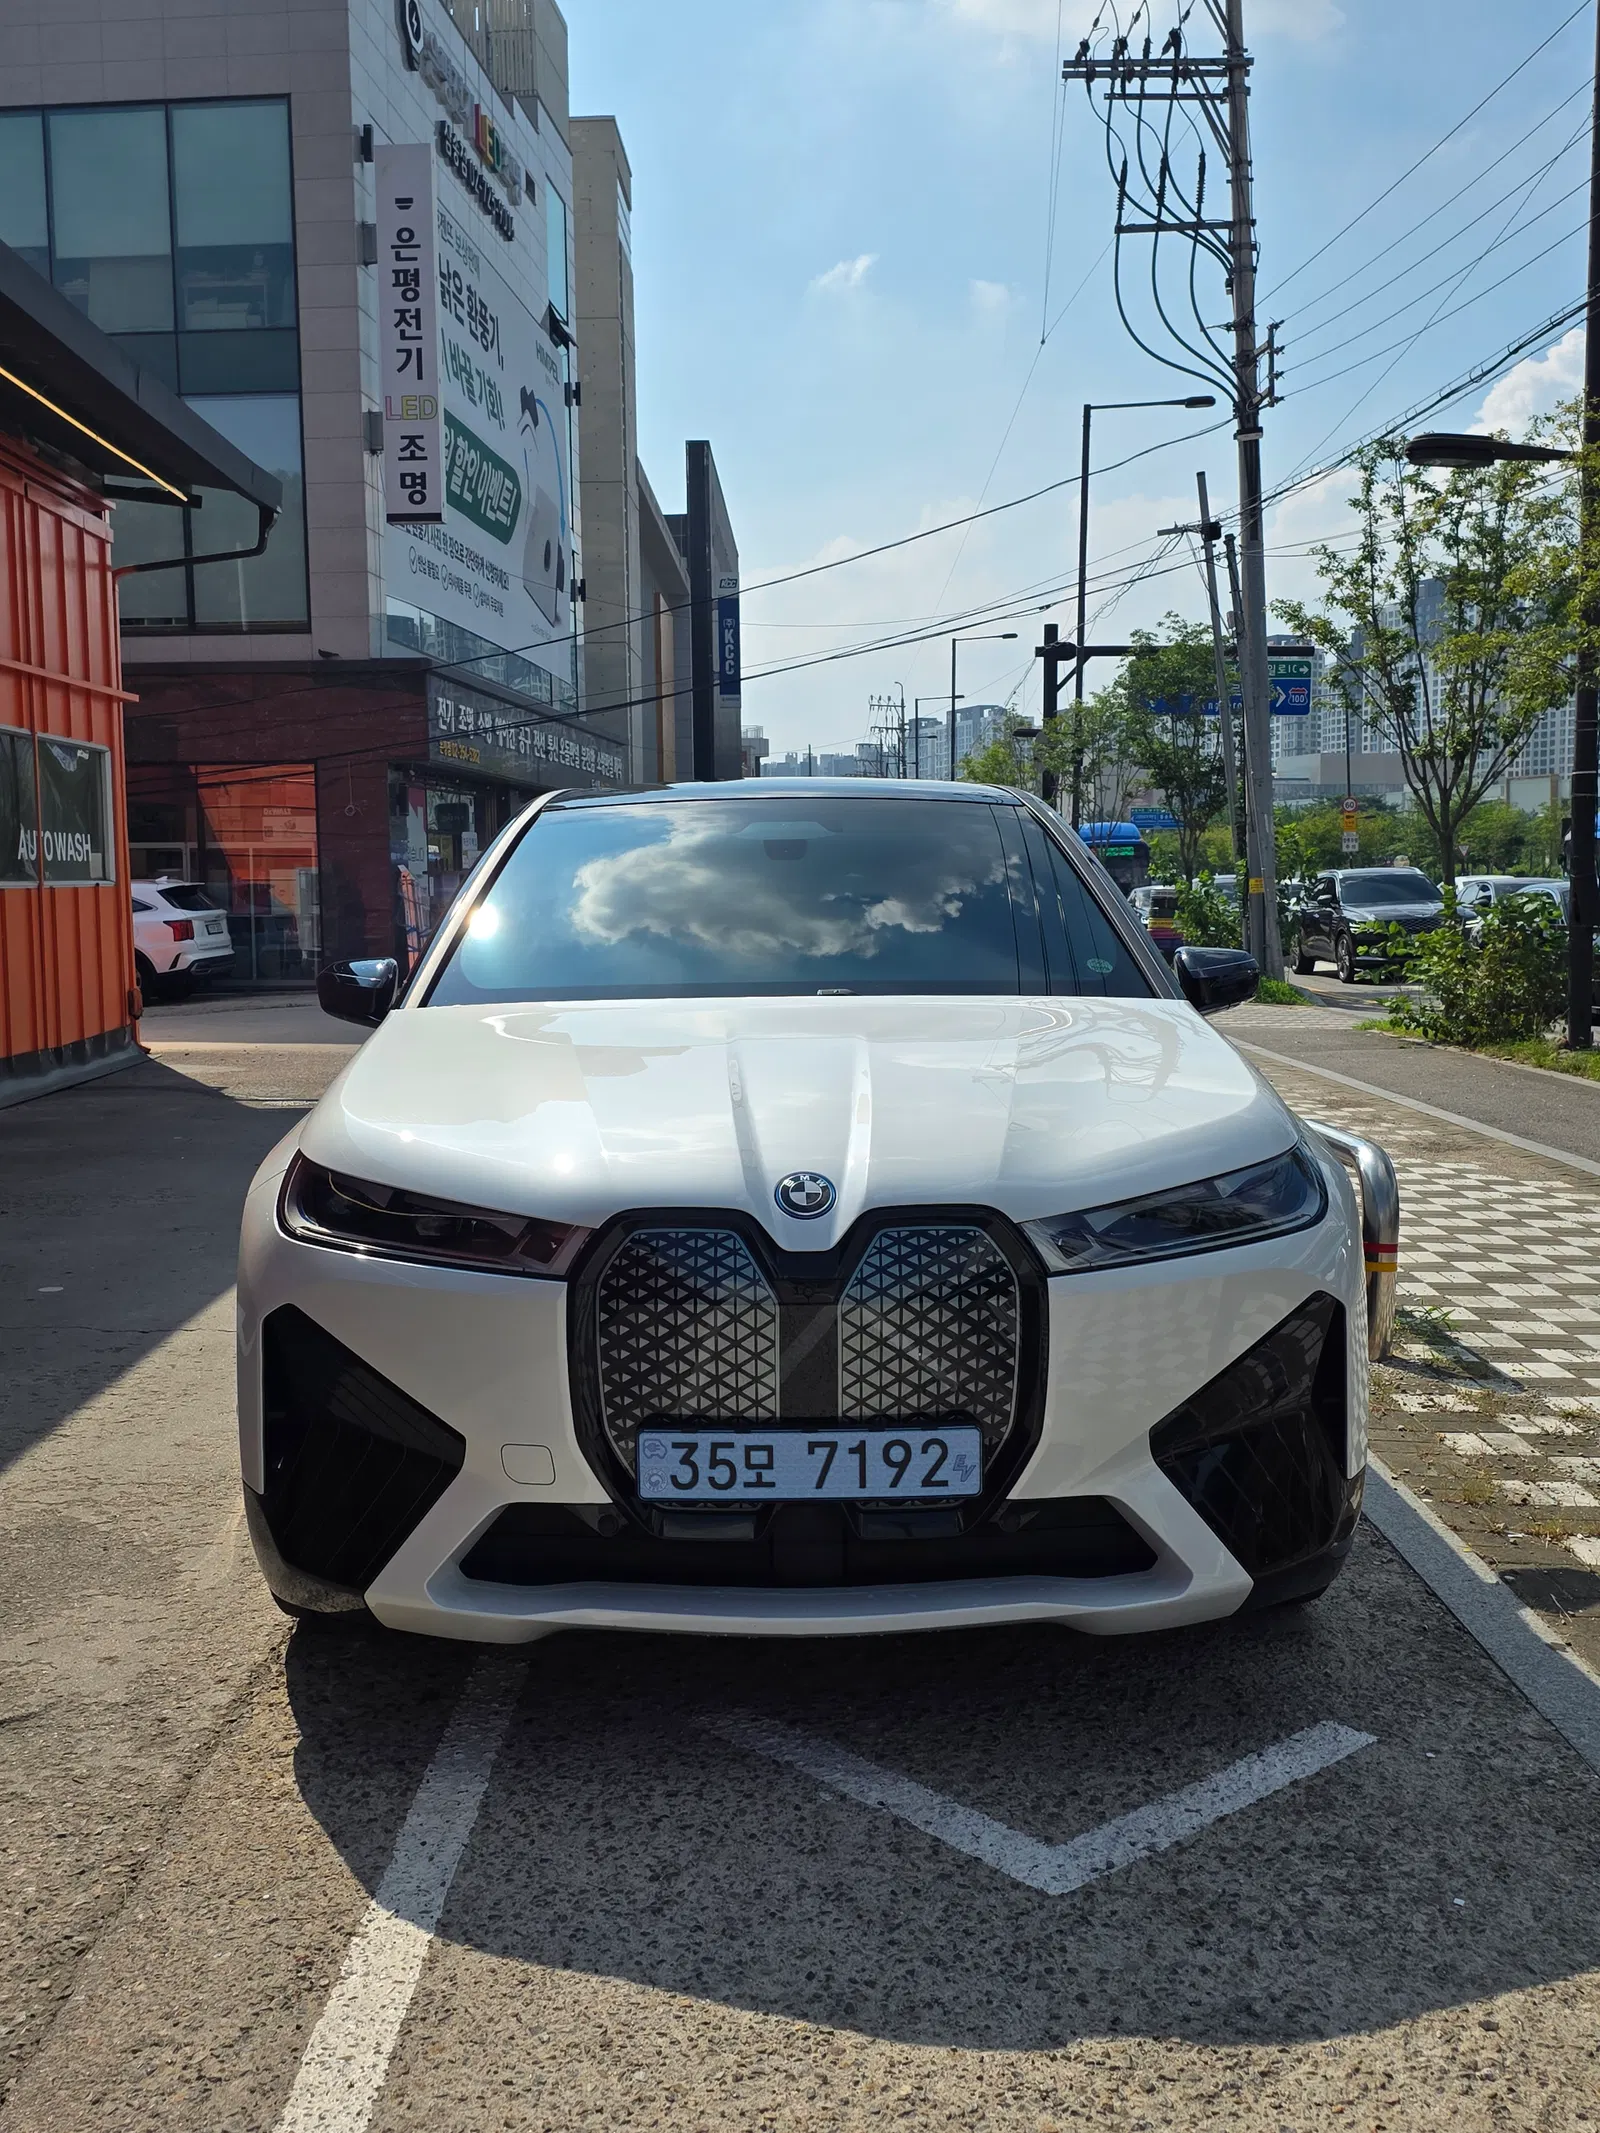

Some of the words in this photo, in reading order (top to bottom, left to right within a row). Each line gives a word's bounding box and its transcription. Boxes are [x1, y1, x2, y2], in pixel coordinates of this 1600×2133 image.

[390, 226, 424, 380] 은평전기
[438, 252, 465, 327] 낡은
[385, 394, 438, 421] LED
[449, 338, 478, 408] 바꿀
[475, 367, 506, 431] 기회!
[398, 434, 428, 505] 조명
[450, 435, 480, 504] 할인
[477, 460, 518, 528] 이벤트!
[721, 579, 736, 588] KCC
[724, 628, 735, 675] KCC
[437, 696, 455, 733] 전기
[1291, 694, 1305, 703] 100
[18, 828, 54, 862] AUO
[53, 831, 91, 862] WASH
[670, 1441, 776, 1491] 35모
[807, 1438, 950, 1490] 7192
[952, 1454, 977, 1483] EV
